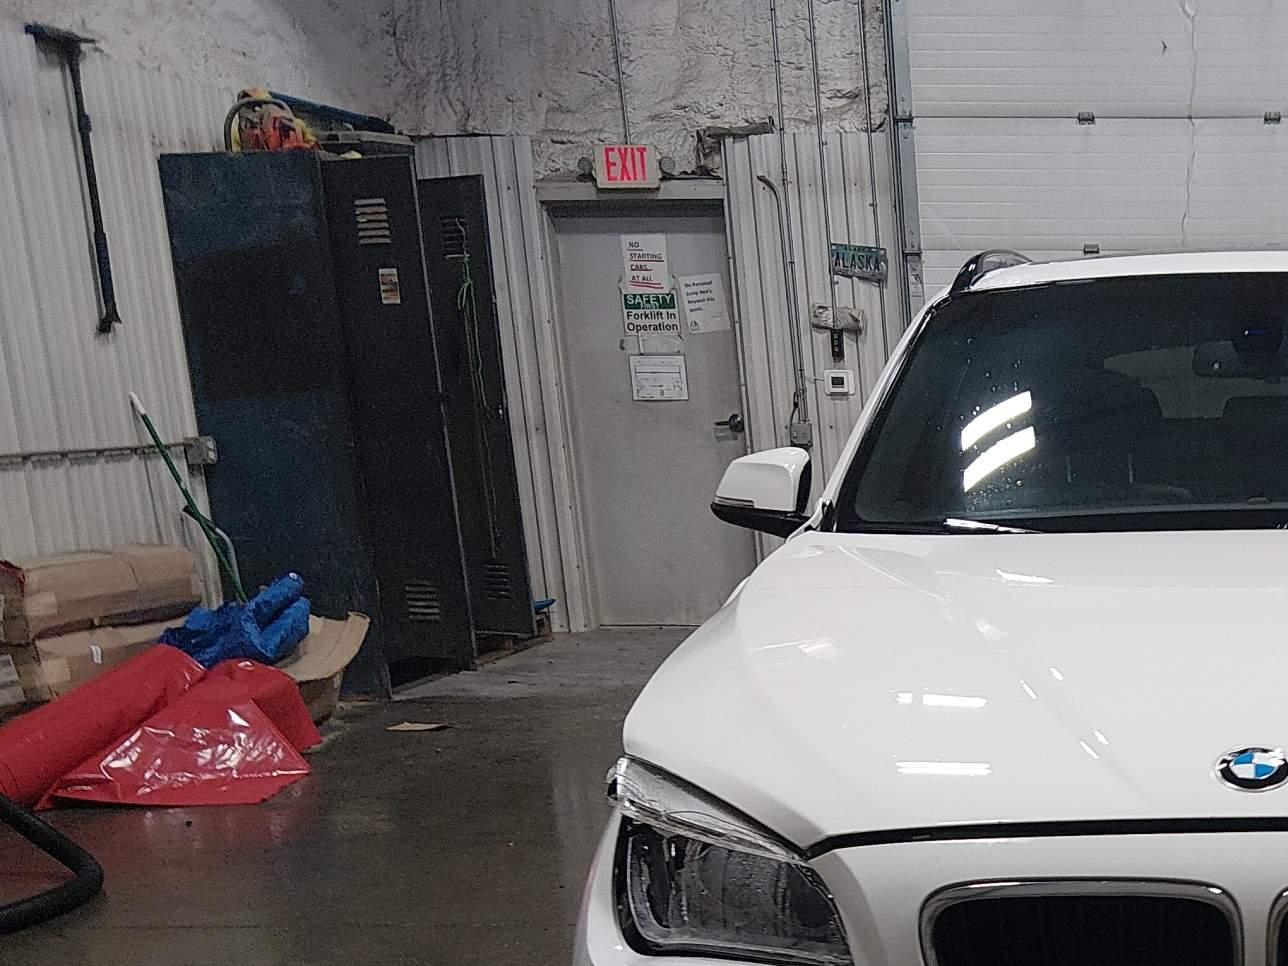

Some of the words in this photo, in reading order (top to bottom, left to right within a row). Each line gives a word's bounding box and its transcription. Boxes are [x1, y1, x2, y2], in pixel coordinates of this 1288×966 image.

[604, 146, 648, 182] EXIT
[629, 252, 663, 260] STARTING
[834, 251, 881, 272] ALASKA
[626, 294, 672, 305] SAFETY
[626, 310, 664, 321] Forklift
[666, 310, 677, 321] In
[626, 321, 679, 333] Operation
